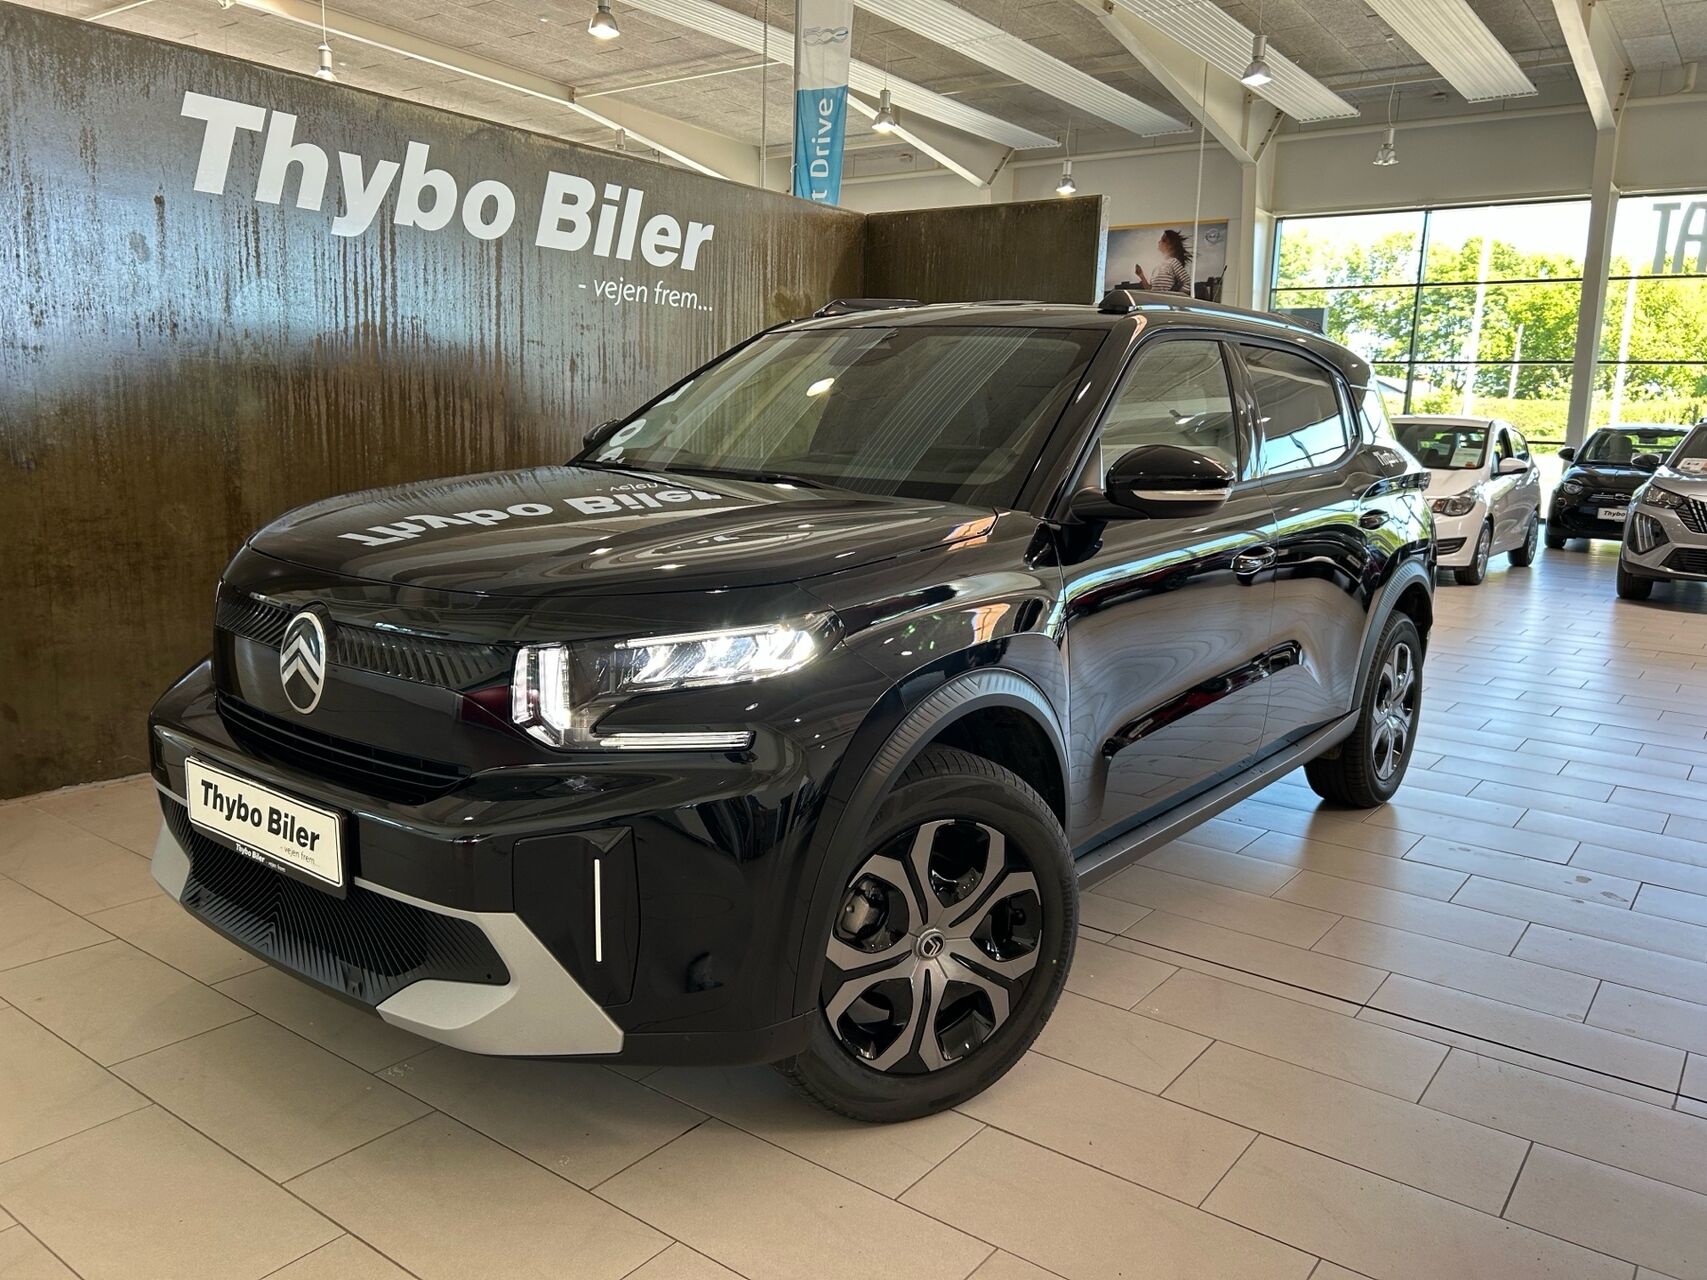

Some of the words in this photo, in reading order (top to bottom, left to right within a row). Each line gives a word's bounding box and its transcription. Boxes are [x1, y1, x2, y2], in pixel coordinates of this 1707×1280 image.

[809, 97, 834, 178] Drive
[180, 91, 515, 241] Thybo
[535, 170, 715, 271] Biler
[594, 276, 649, 306] vejen
[654, 280, 713, 312] frem...
[1604, 510, 1626, 518] Thybo
[201, 778, 262, 828] Thybo
[267, 806, 320, 852] Biler
[235, 843, 252, 857] Thybo
[252, 850, 265, 863] Biler
[284, 846, 300, 858] vejen
